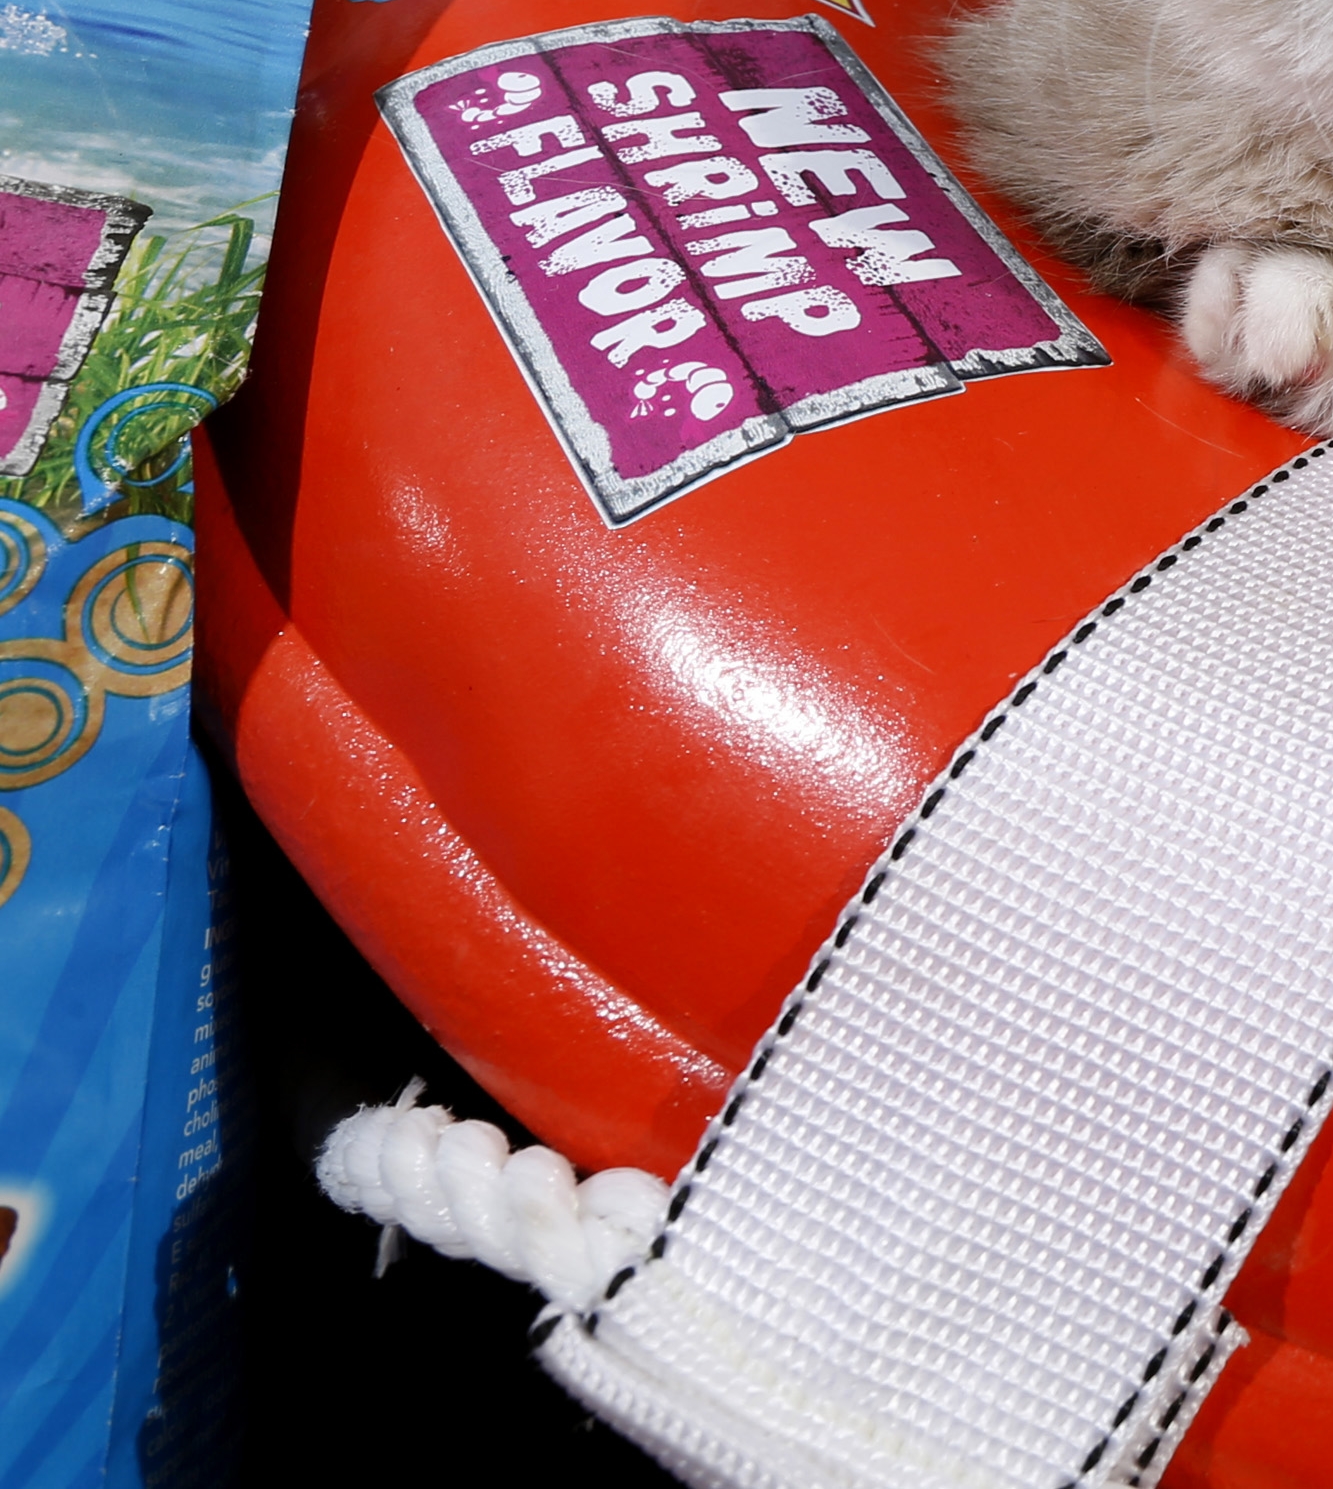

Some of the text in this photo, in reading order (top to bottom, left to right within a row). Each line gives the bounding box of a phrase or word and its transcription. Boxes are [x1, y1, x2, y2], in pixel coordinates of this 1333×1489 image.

[470, 120, 706, 368] FLAVOR
[718, 85, 962, 287] NEW
[178, 1128, 218, 1170] meal,
